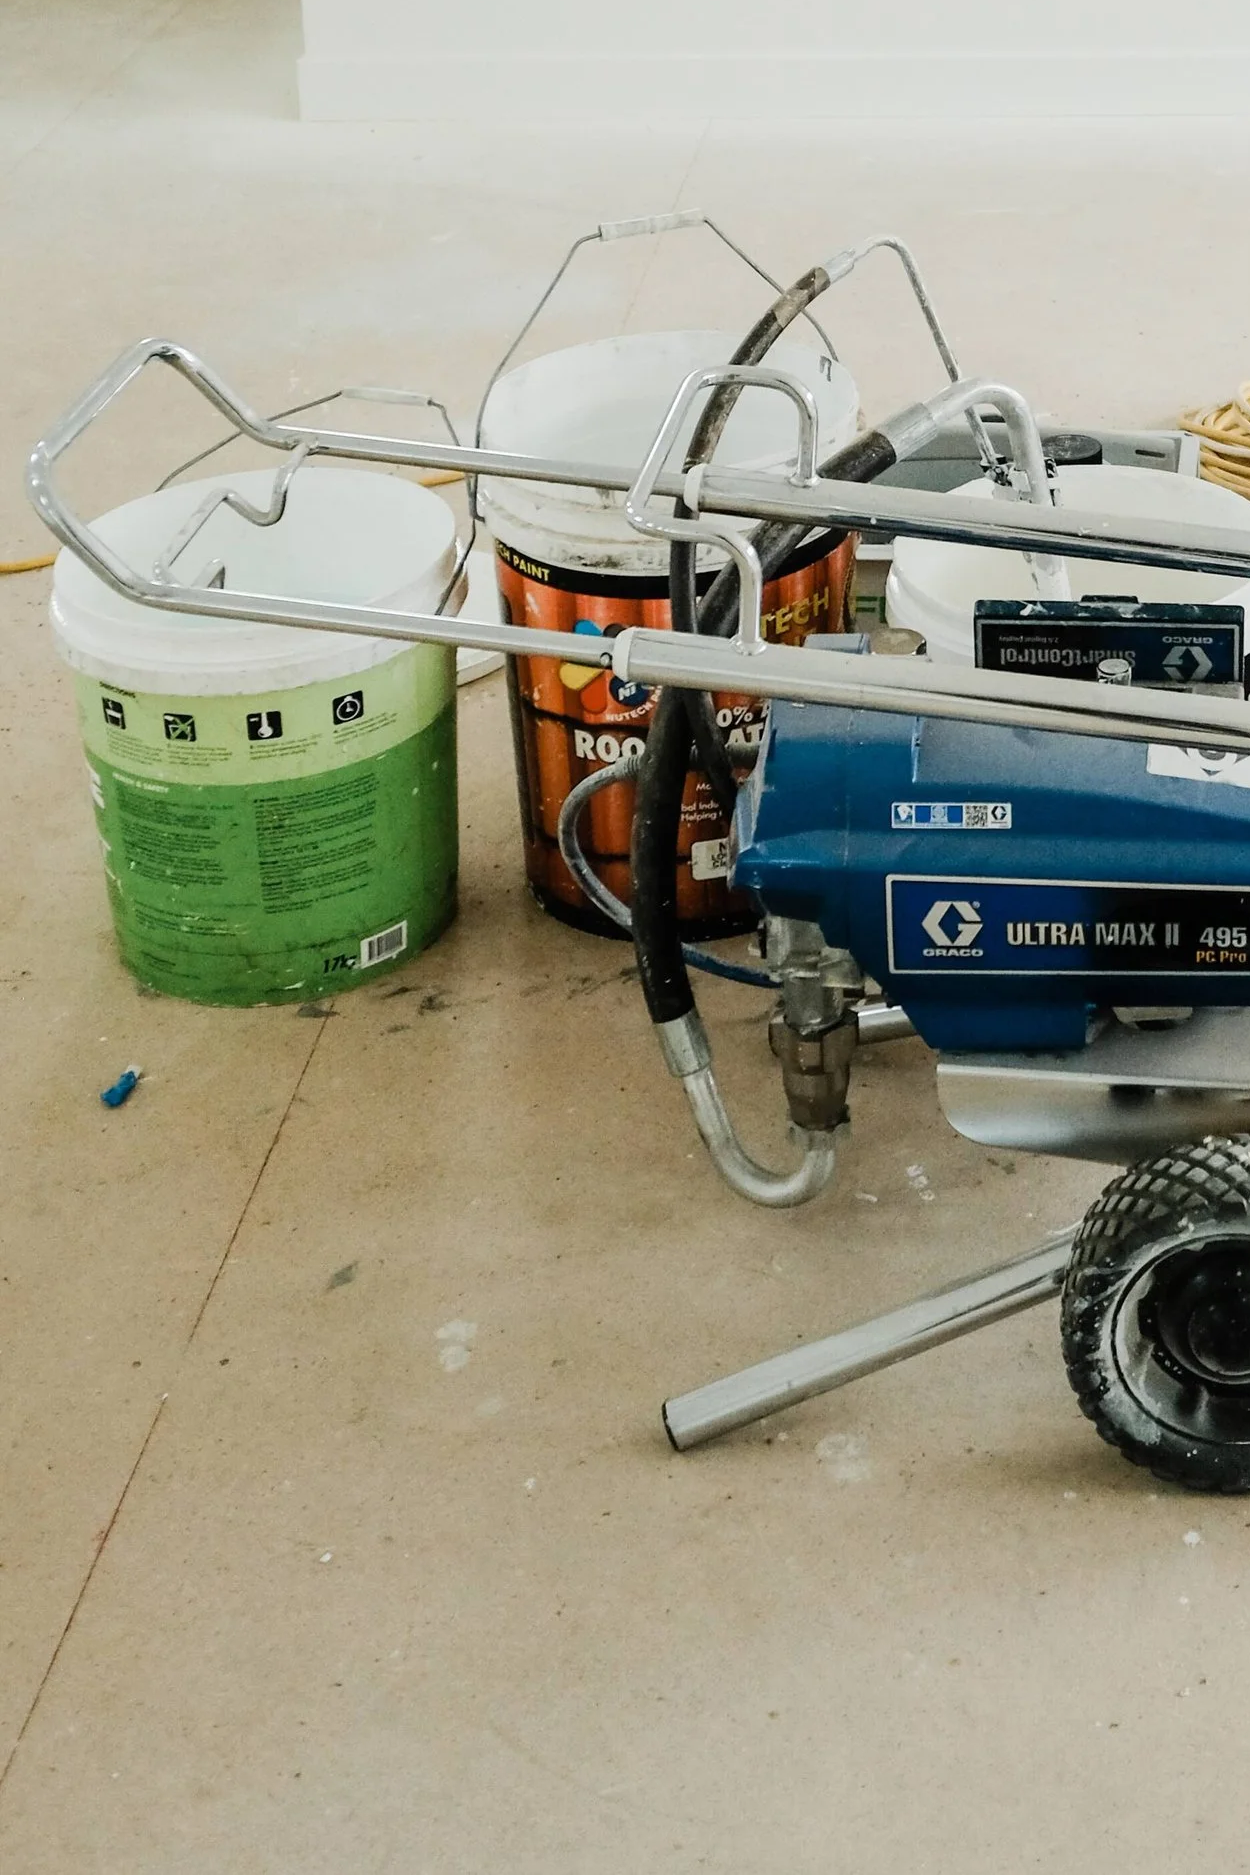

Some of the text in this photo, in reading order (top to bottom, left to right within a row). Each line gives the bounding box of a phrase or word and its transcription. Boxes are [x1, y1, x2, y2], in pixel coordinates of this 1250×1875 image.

[512, 554, 550, 582] PAINT
[1162, 635, 1214, 645] GRACO
[1006, 922, 1086, 947] ULTRA
[1095, 922, 1156, 947] MAX
[1198, 926, 1248, 948] 495
[922, 948, 984, 958] GRACO
[1196, 950, 1247, 963] PC Pro
